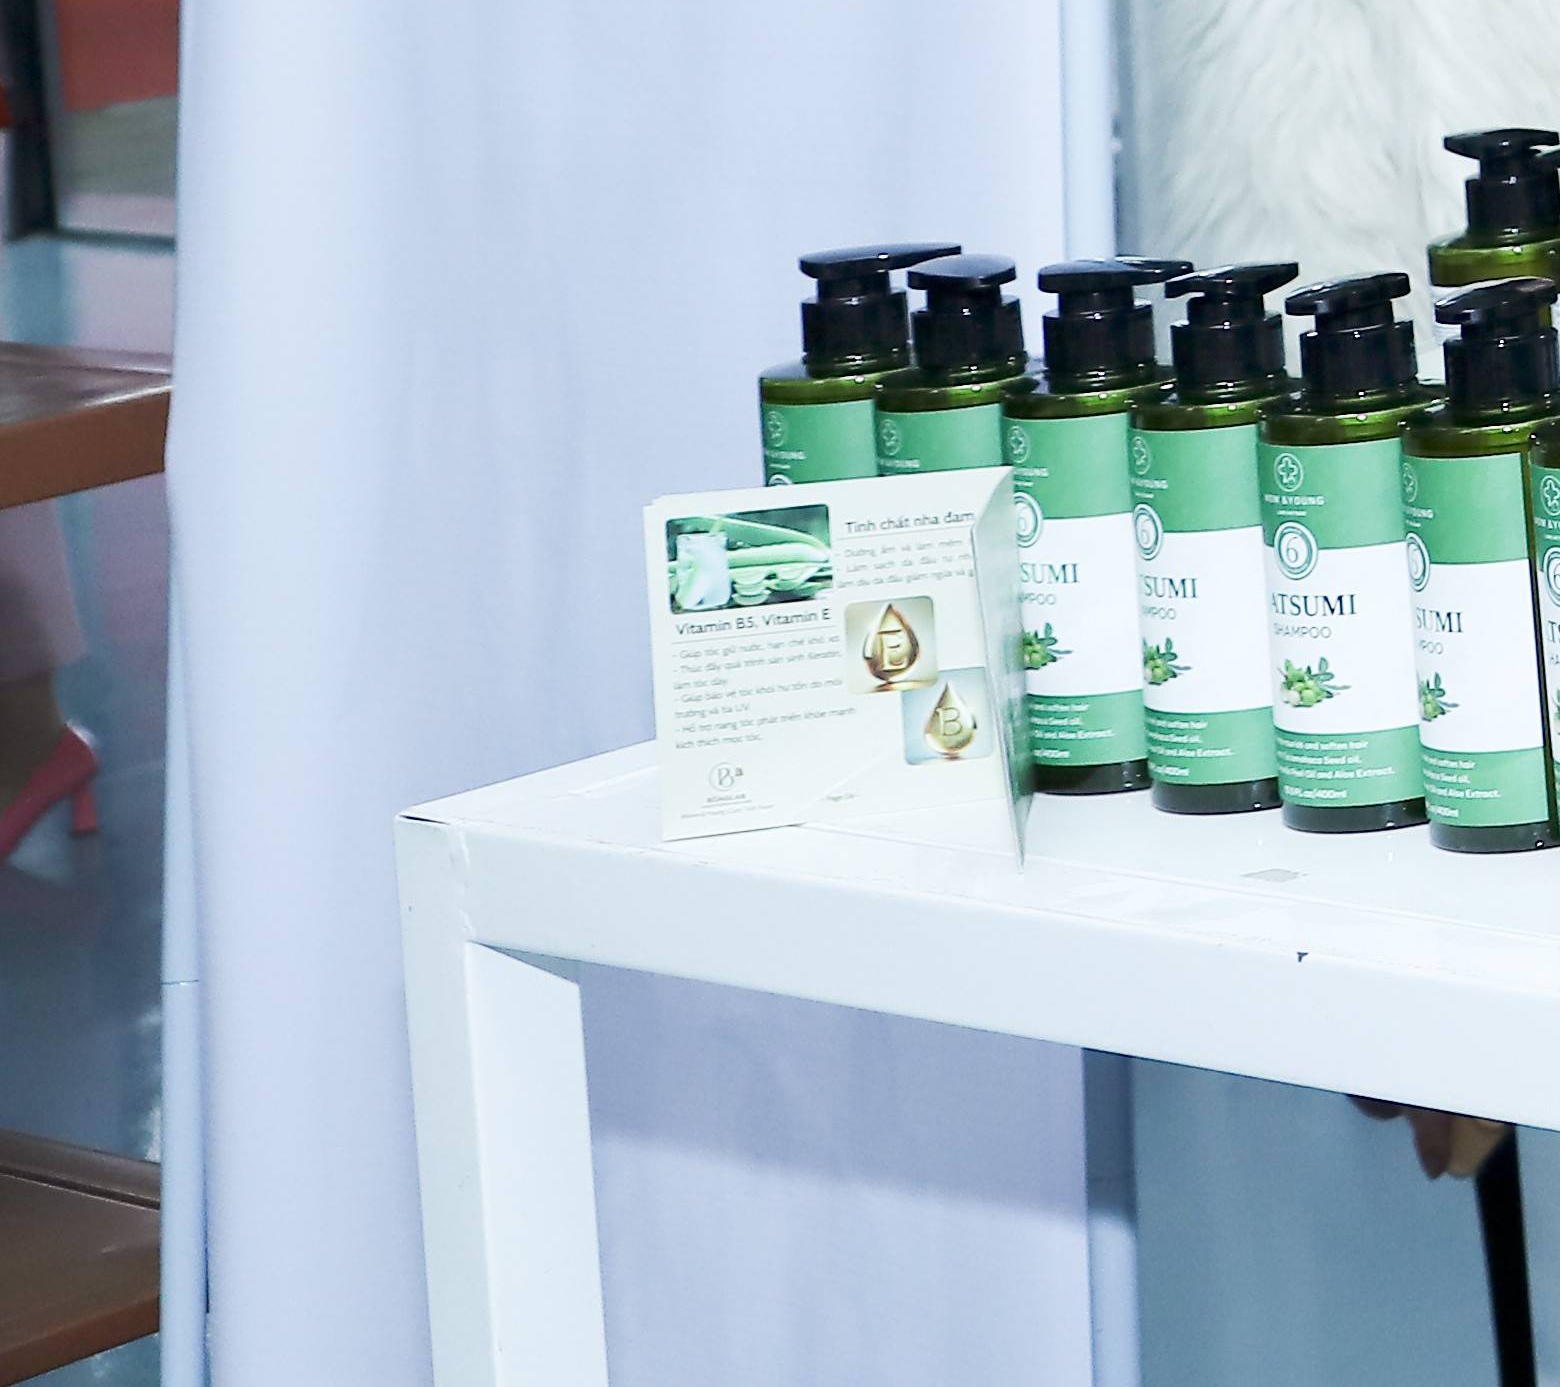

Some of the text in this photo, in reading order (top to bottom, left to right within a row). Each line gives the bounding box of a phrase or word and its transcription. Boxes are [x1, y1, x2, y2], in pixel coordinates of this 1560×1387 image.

[676, 620, 732, 636] Vitamin
[762, 610, 818, 627] Vitamin
[822, 608, 830, 620] E
